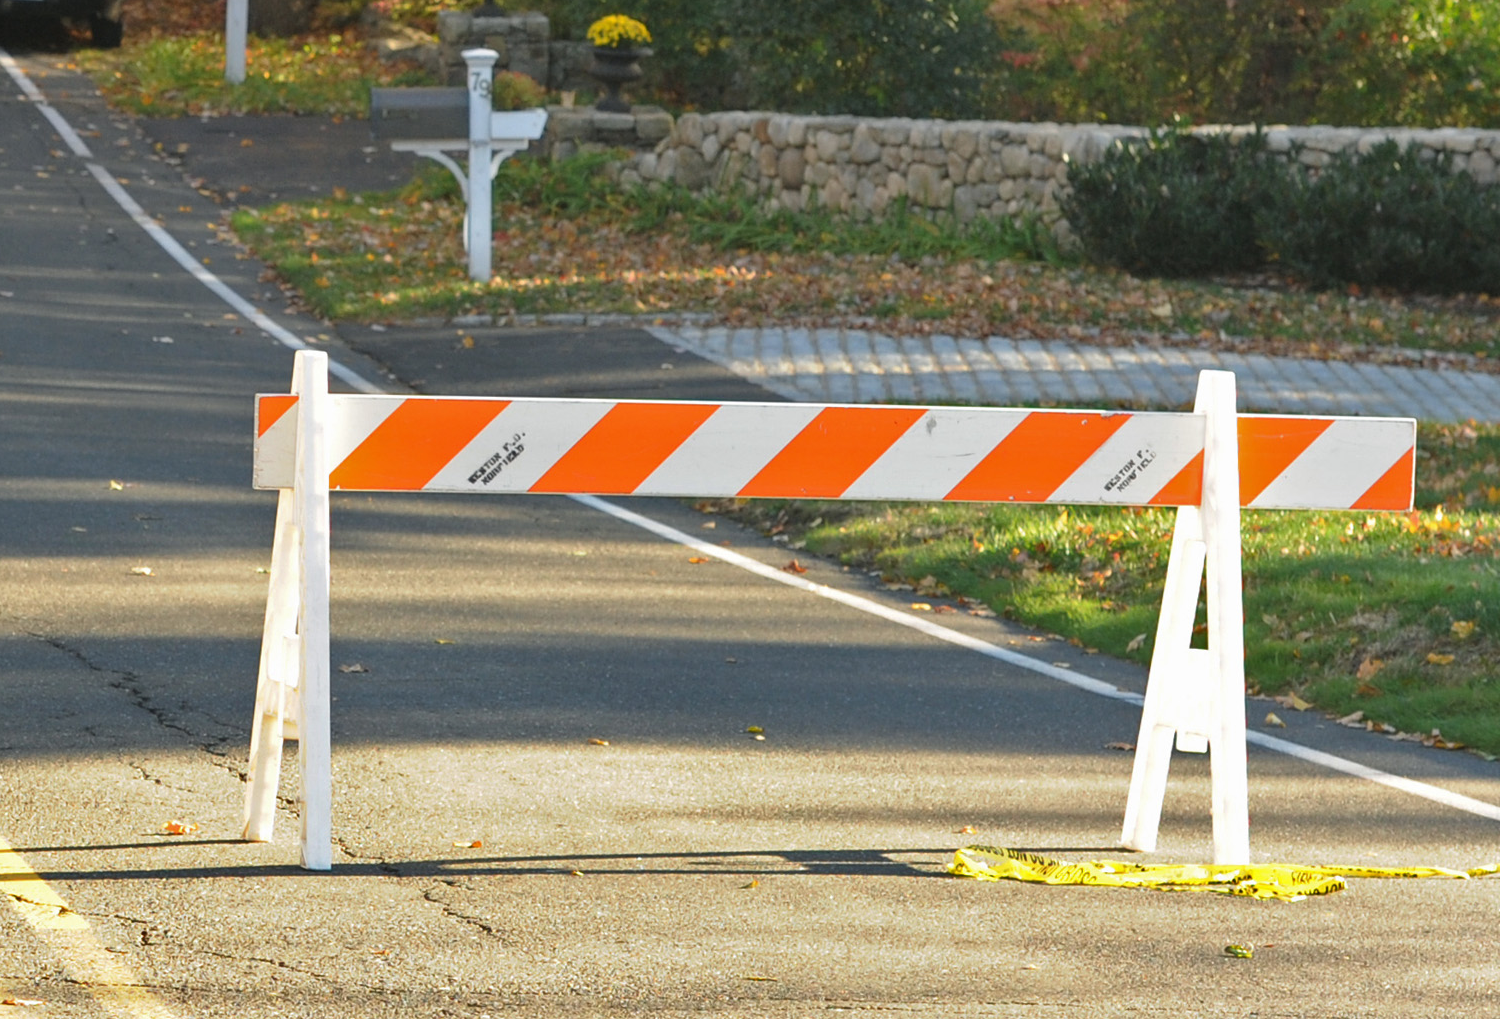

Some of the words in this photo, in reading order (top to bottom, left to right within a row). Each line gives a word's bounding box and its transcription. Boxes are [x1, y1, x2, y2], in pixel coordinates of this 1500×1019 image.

[472, 72, 492, 99] 79
[467, 452, 502, 484] WESTON
[1104, 459, 1136, 491] WESTON
